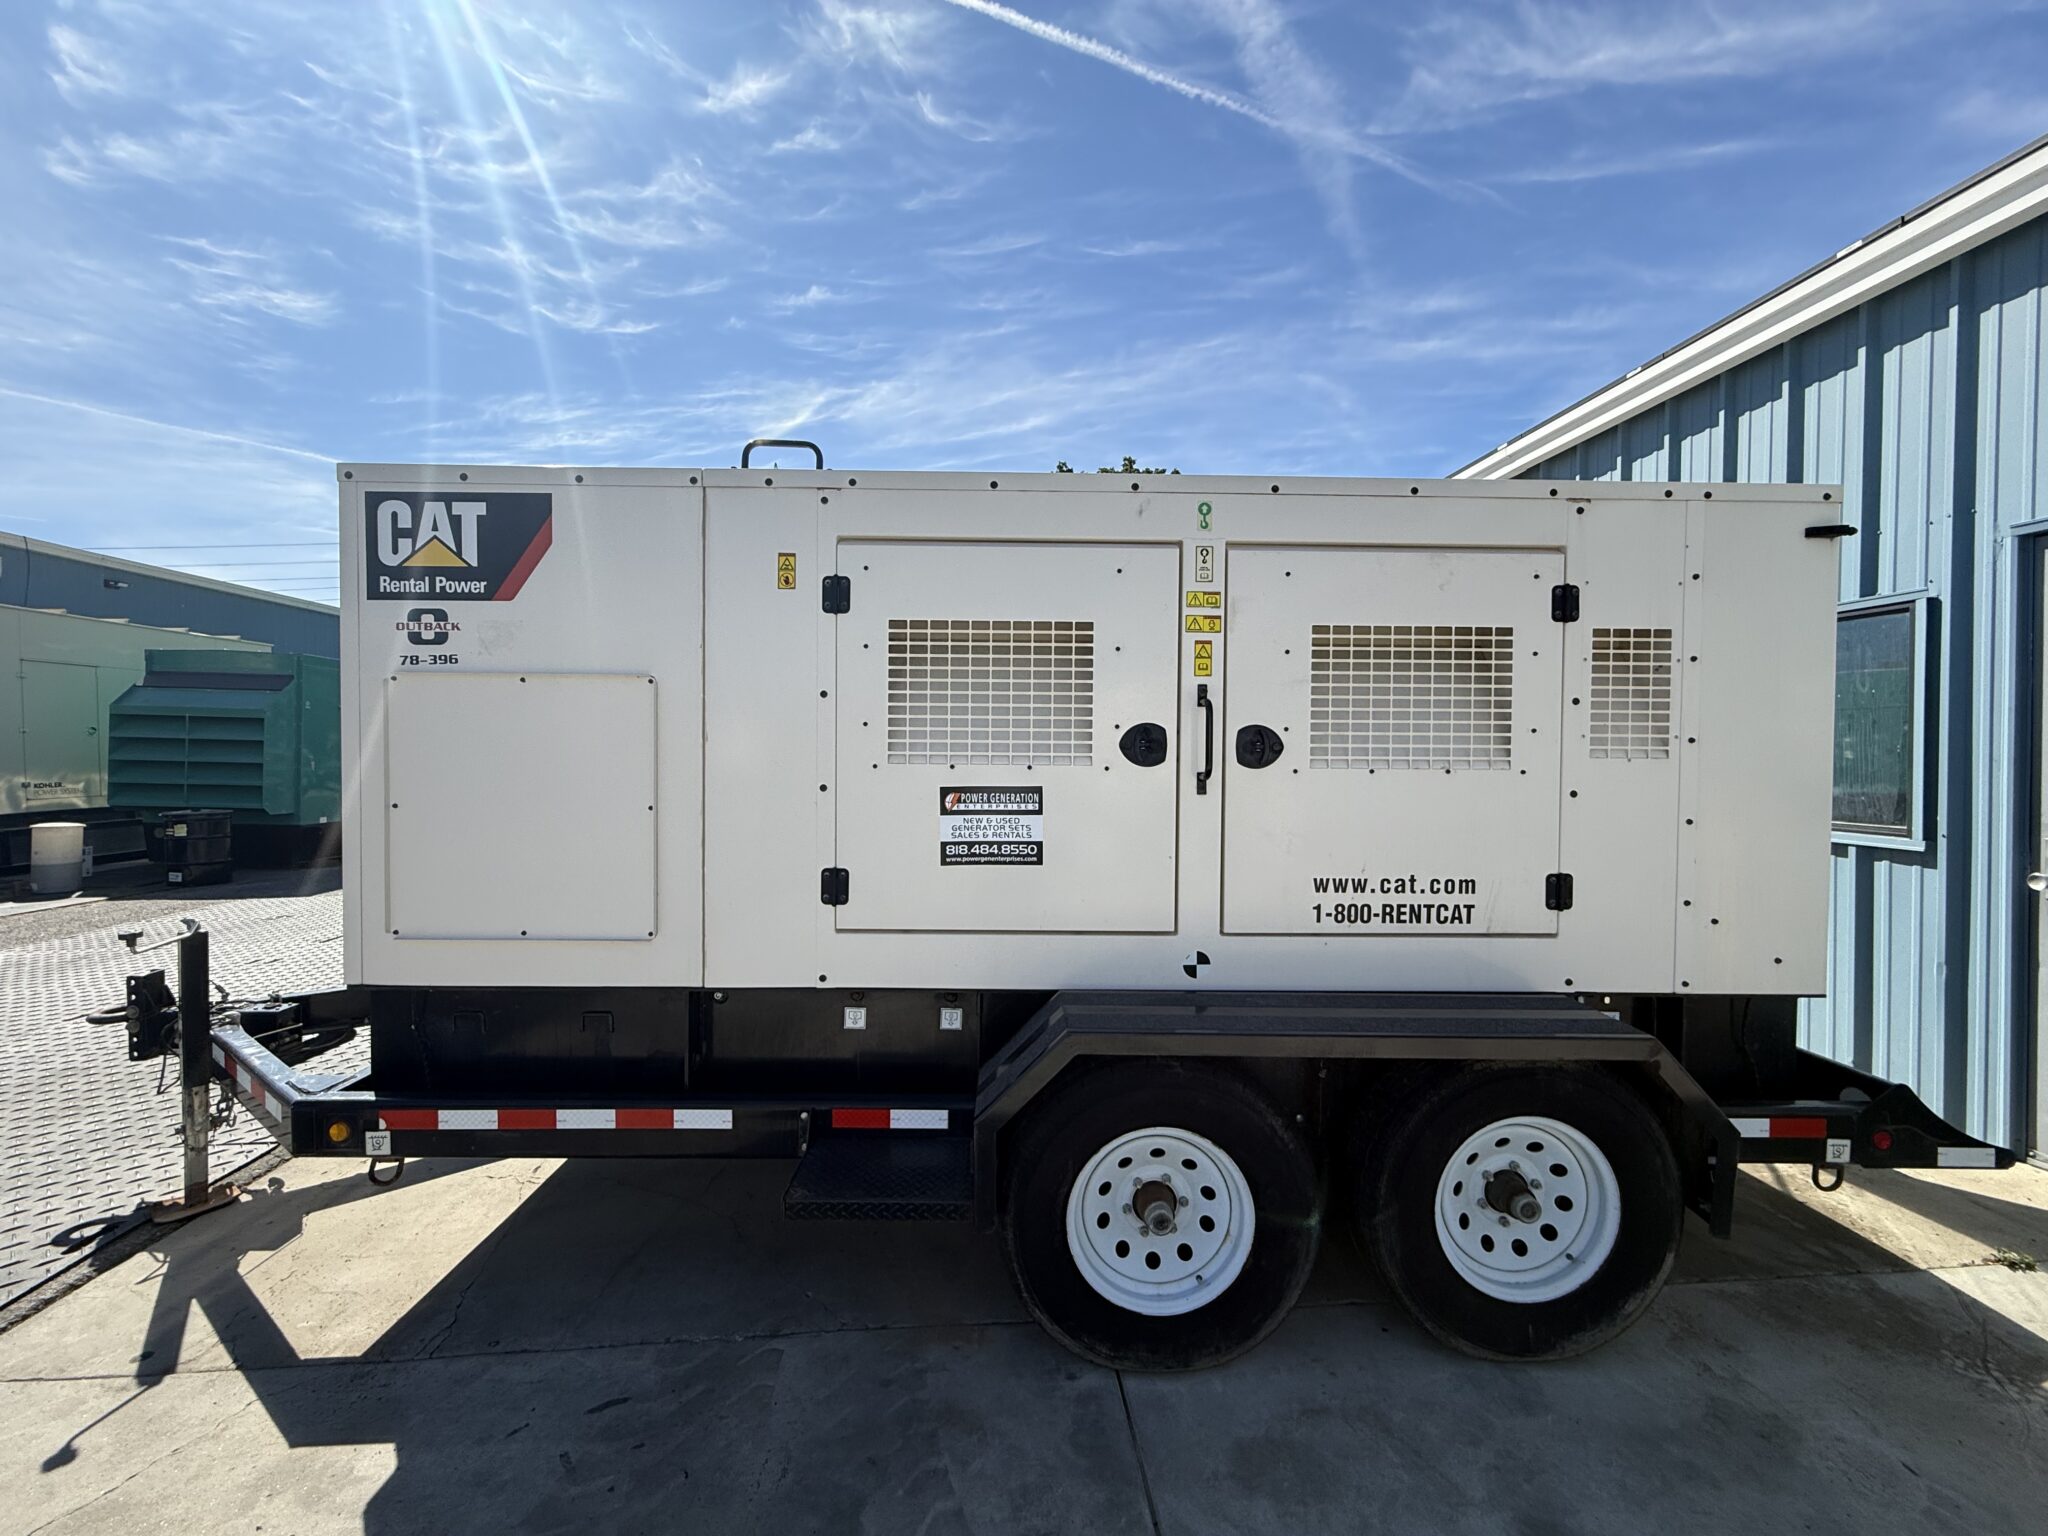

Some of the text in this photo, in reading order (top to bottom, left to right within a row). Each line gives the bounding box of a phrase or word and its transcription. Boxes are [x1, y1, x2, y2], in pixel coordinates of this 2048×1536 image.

[377, 499, 487, 567] CAT
[379, 575, 487, 594] Rental Power
[395, 621, 461, 632] OUTBACK
[399, 653, 459, 666] 78-396
[960, 792, 1039, 803] POWER GENERATION
[962, 817, 1021, 825] NEW & USED
[951, 824, 1032, 832] GENERATOR SETS
[951, 831, 1033, 839] SALES & RENTALS
[945, 844, 1038, 855] 818.484.8550
[945, 855, 1038, 863] www.powergenenterprises.com
[1313, 874, 1477, 895] www.cat.com
[1312, 903, 1476, 925] 1-800-RENTCAT
